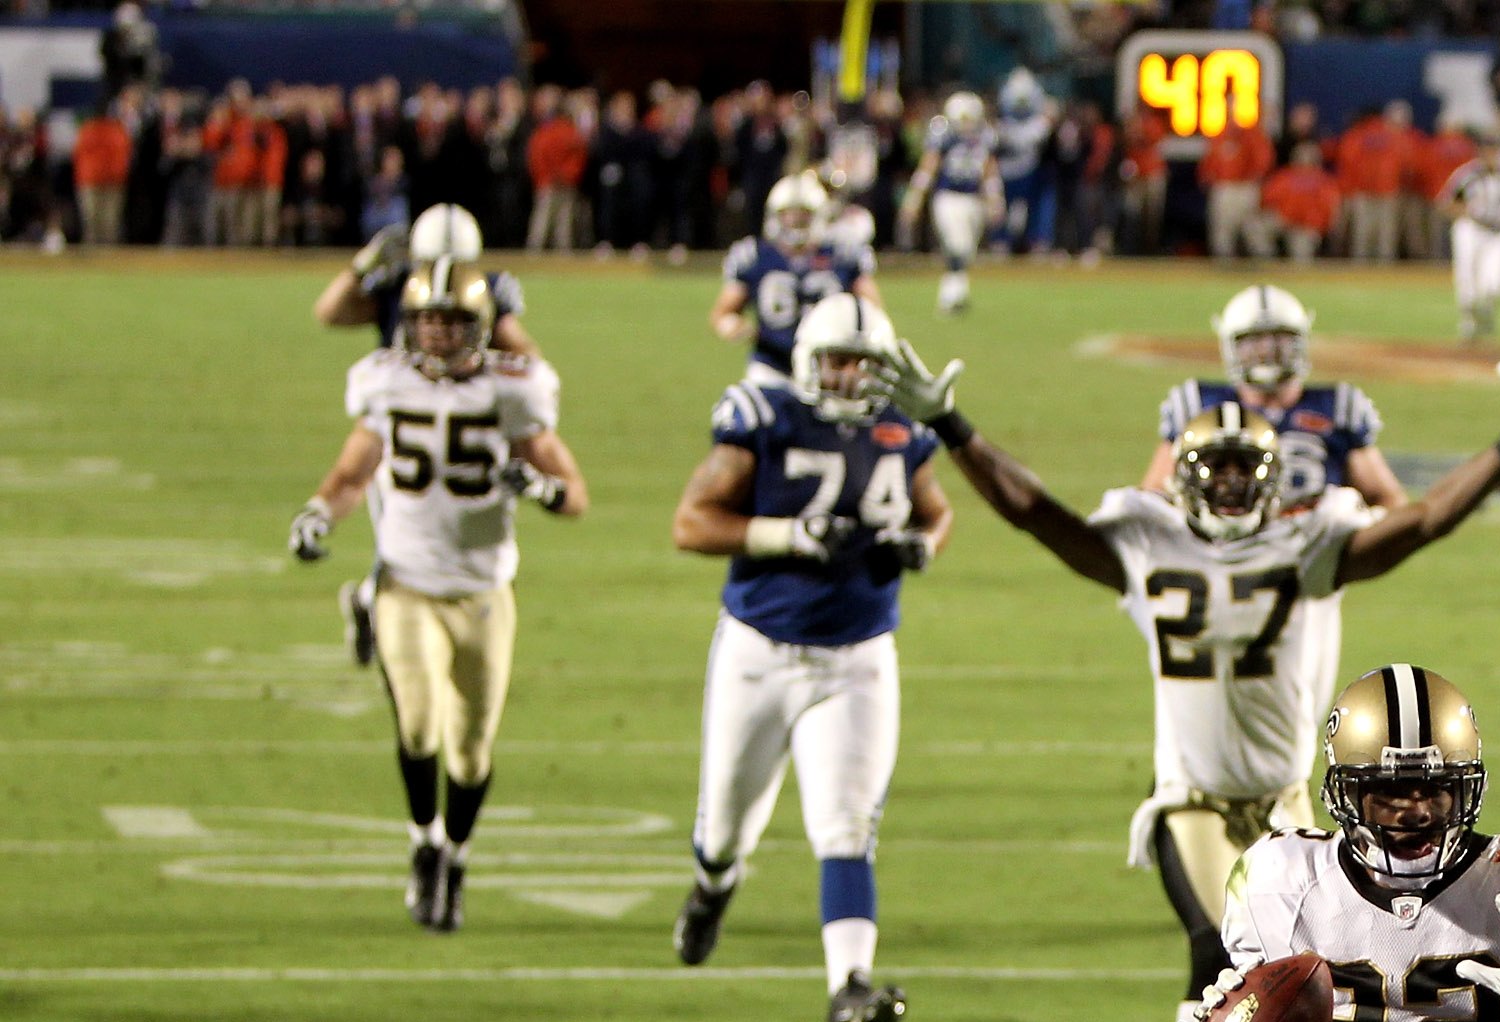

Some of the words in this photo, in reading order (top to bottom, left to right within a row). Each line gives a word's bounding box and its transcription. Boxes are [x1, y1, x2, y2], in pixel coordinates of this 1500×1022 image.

[1139, 48, 1259, 137] 40
[388, 409, 501, 497] 55
[783, 446, 913, 532] 74
[1145, 563, 1300, 680] 27
